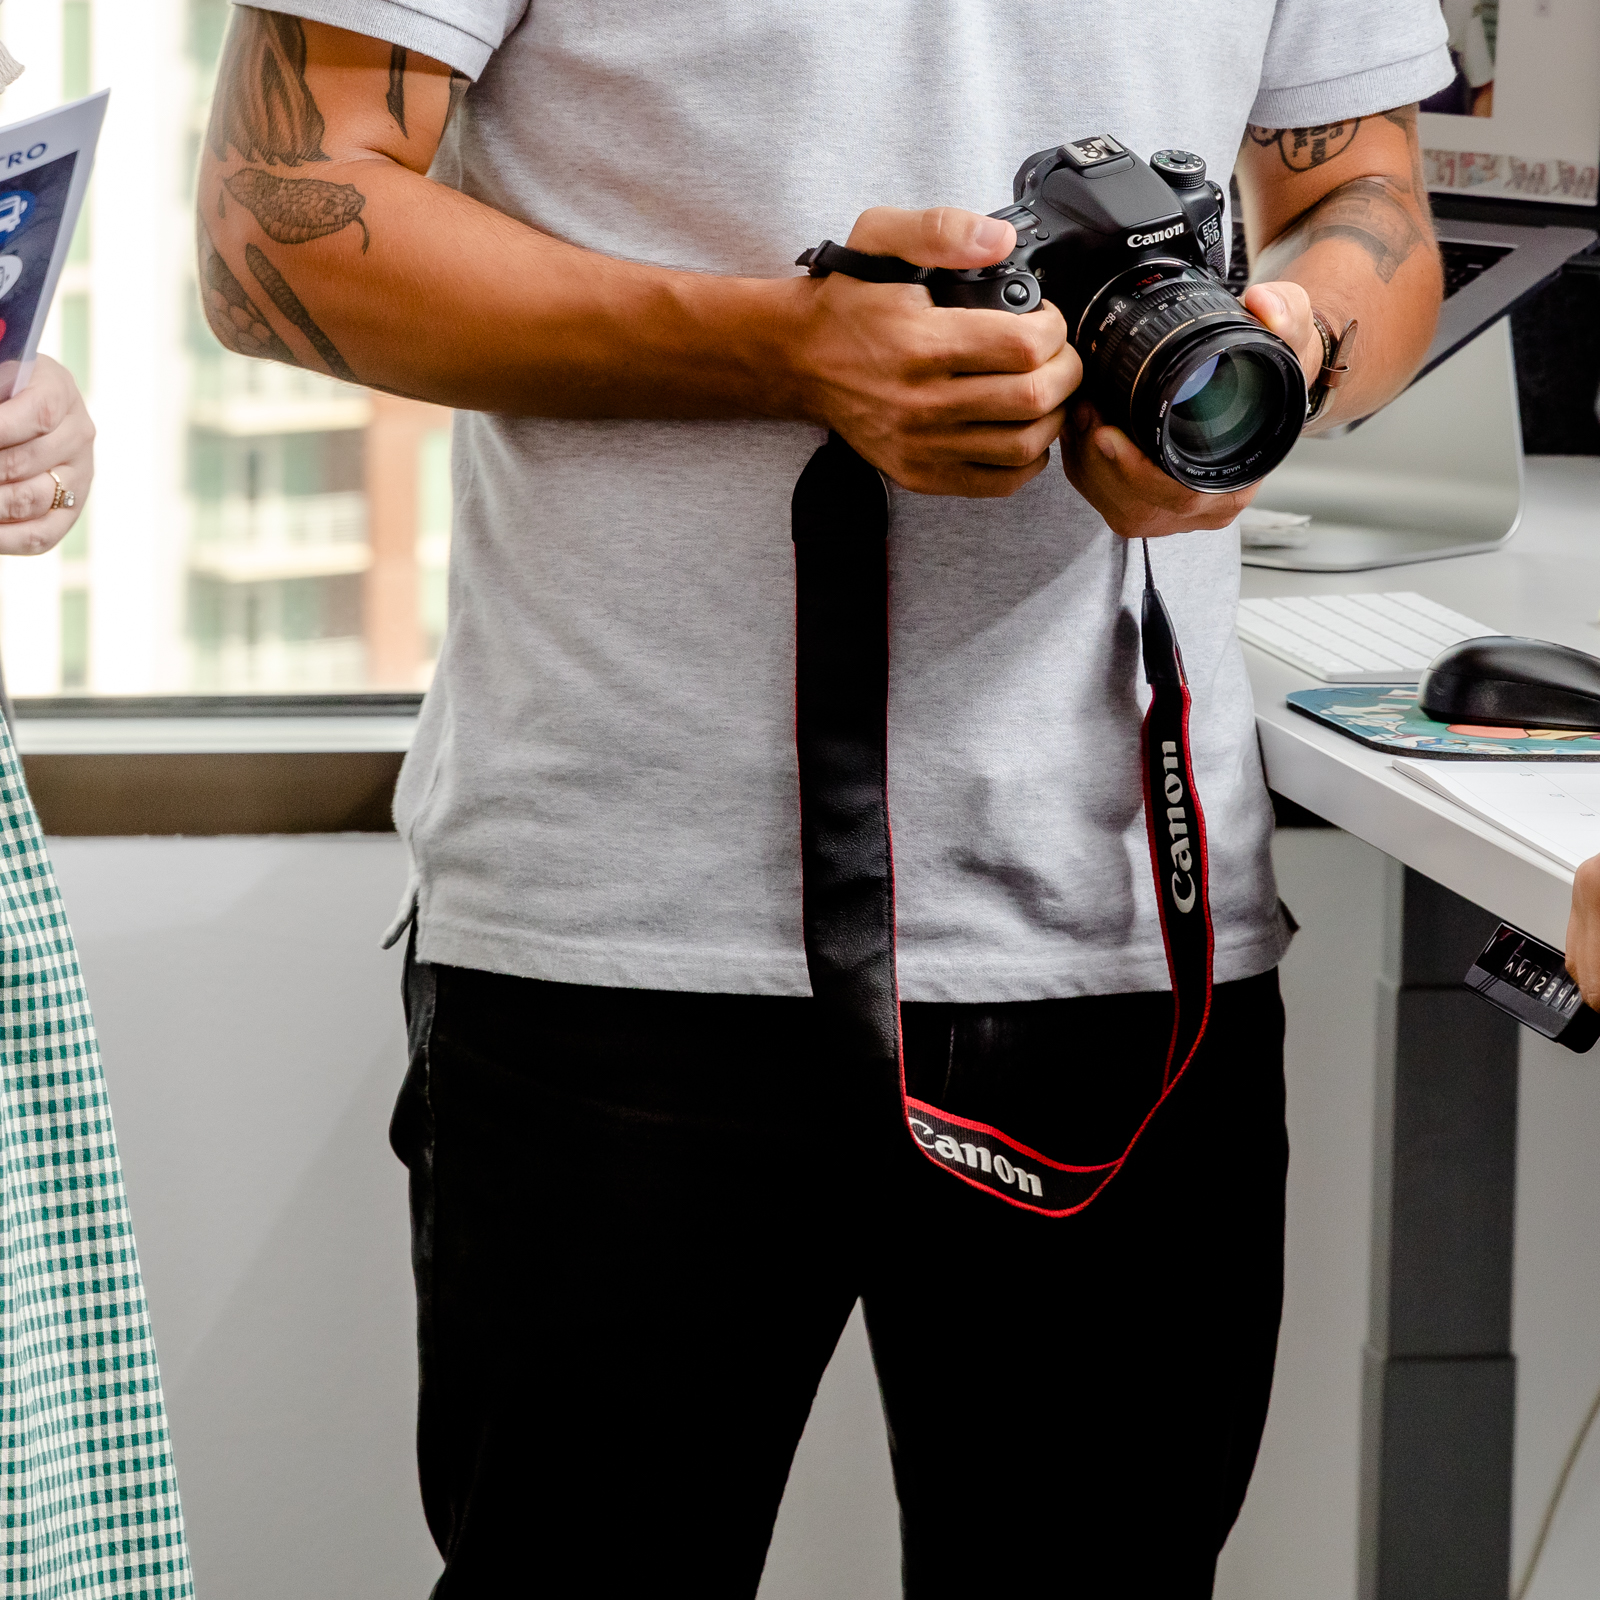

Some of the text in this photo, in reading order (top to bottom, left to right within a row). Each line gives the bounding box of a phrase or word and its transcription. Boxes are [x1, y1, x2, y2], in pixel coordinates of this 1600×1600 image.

[1126, 221, 1185, 249] Canon
[1202, 217, 1219, 236] EOS
[1204, 229, 1220, 249] 70D
[1099, 300, 1127, 332] 24-85mm
[1158, 302, 1169, 311] 50
[1139, 316, 1149, 326] 70
[1186, 466, 1206, 477] JAPAN
[1221, 464, 1241, 475] MADE
[1161, 741, 1196, 914] Canon
[907, 1116, 1044, 1197] Canon
